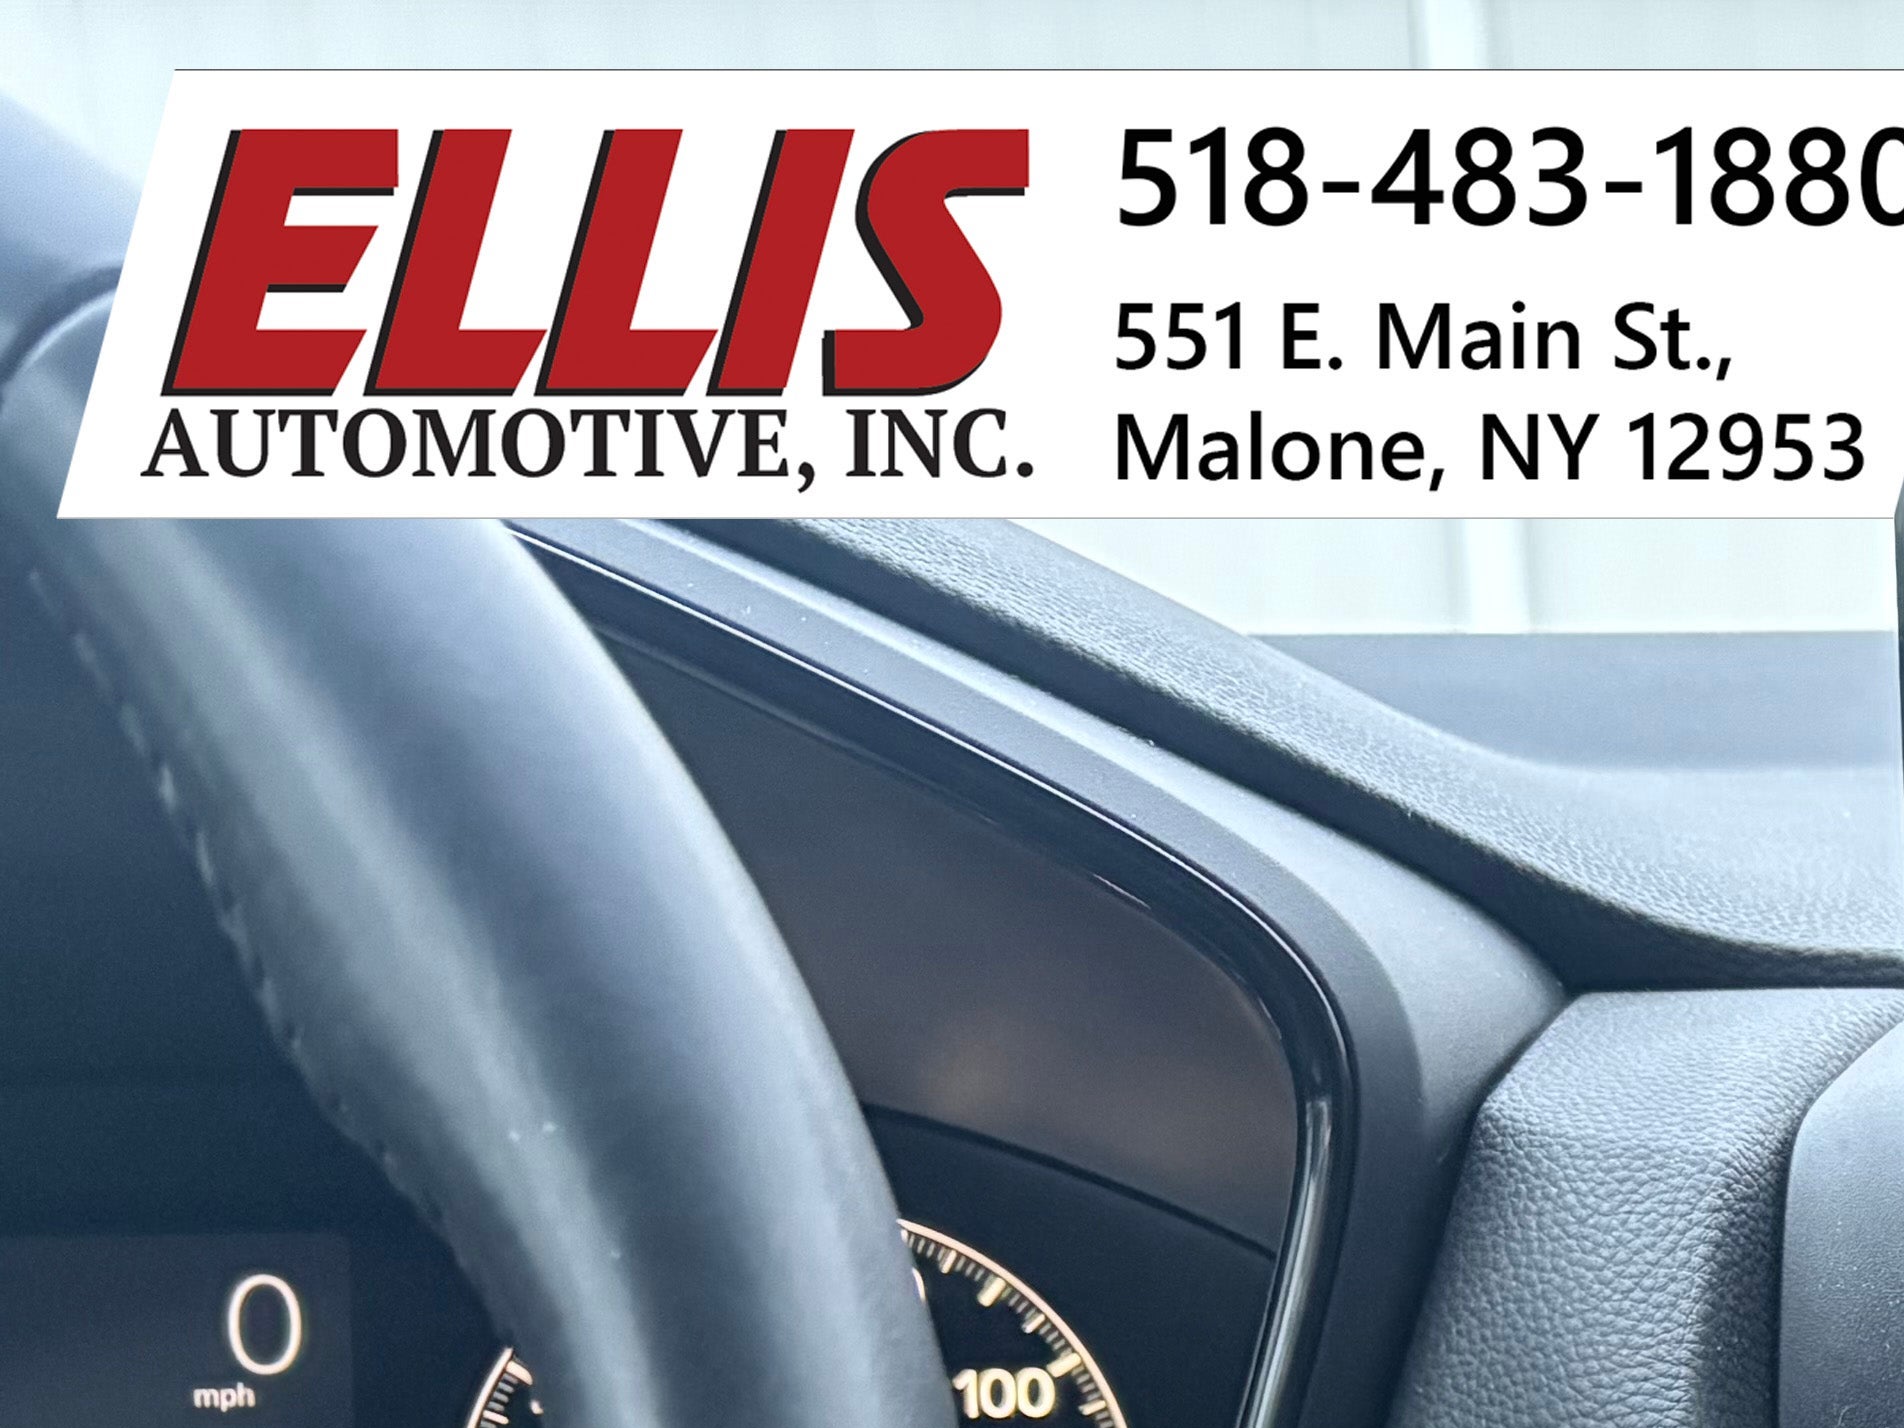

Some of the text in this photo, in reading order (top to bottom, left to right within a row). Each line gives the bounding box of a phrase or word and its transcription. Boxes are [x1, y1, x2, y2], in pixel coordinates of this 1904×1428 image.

[227, 1273, 302, 1376] 0
[193, 1381, 256, 1413] mph
[953, 1366, 1056, 1419] 100
